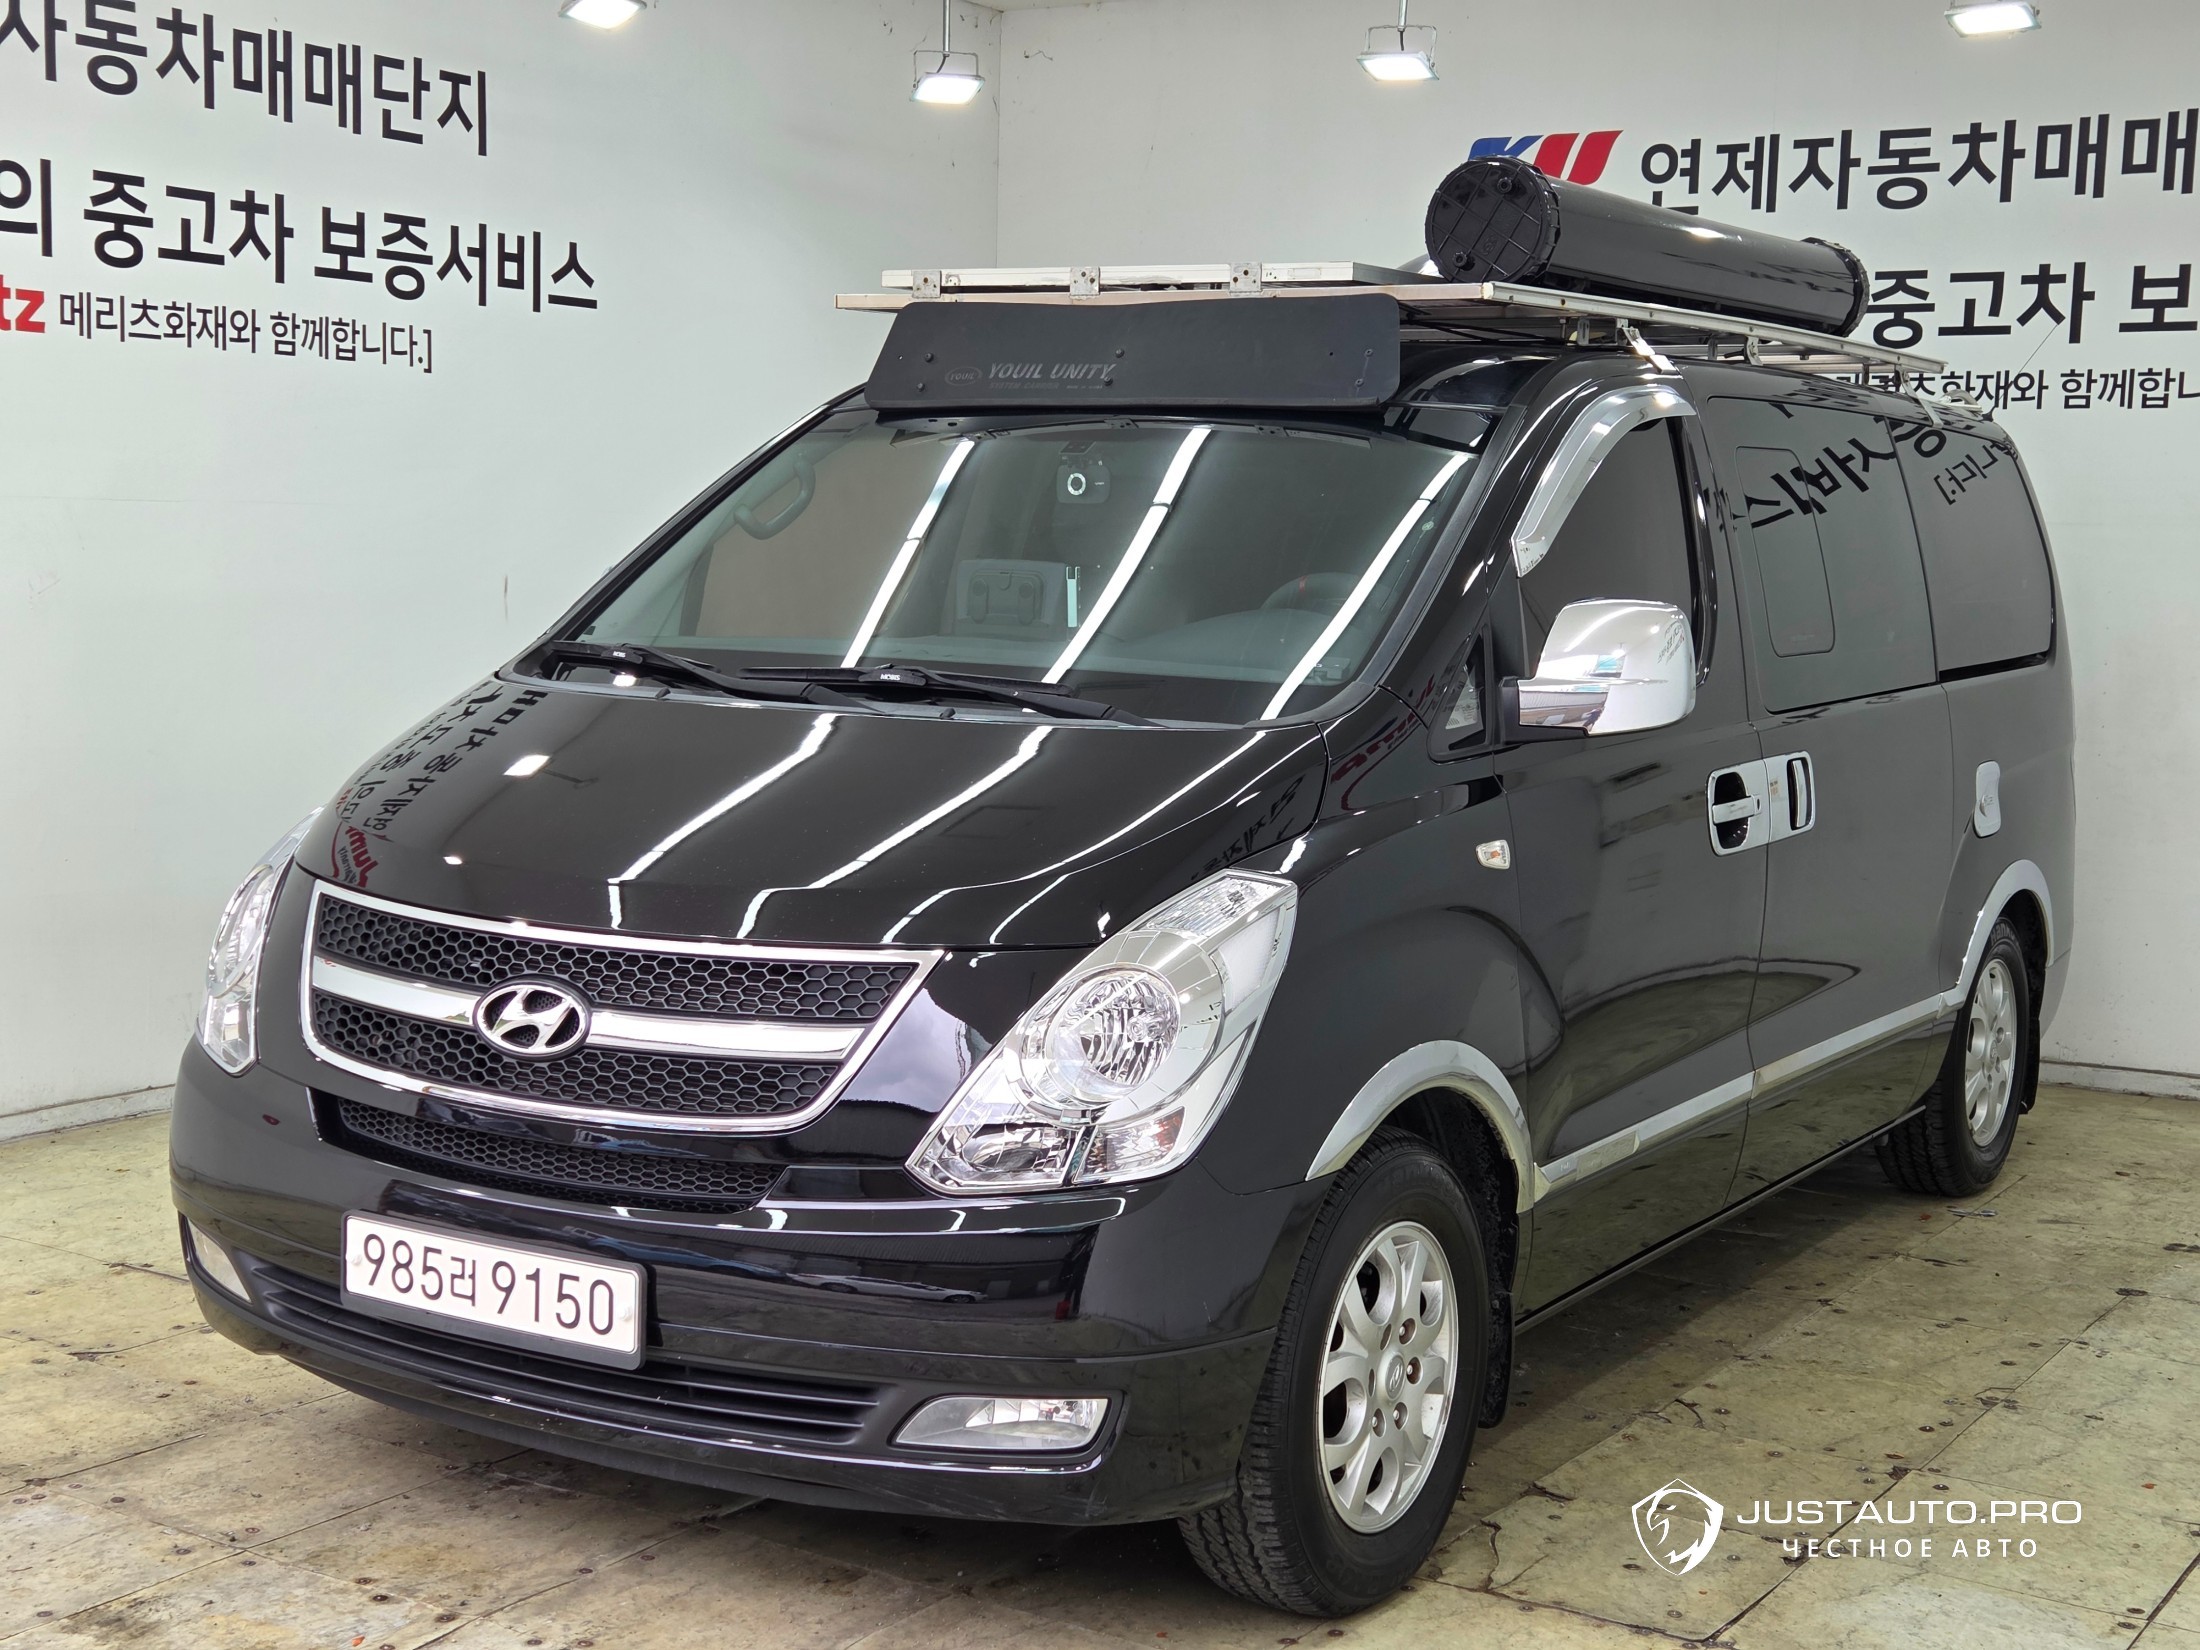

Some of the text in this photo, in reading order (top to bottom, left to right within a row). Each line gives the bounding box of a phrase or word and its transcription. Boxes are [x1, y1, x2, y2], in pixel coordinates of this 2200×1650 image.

[83, 169, 294, 284] 중고차
[314, 206, 598, 313] 보증서비스
[59, 292, 261, 354] 메리츠화재와
[1868, 261, 2095, 350] 중고차
[988, 363, 1043, 379] YOUIL
[1050, 363, 1117, 379] UNITY
